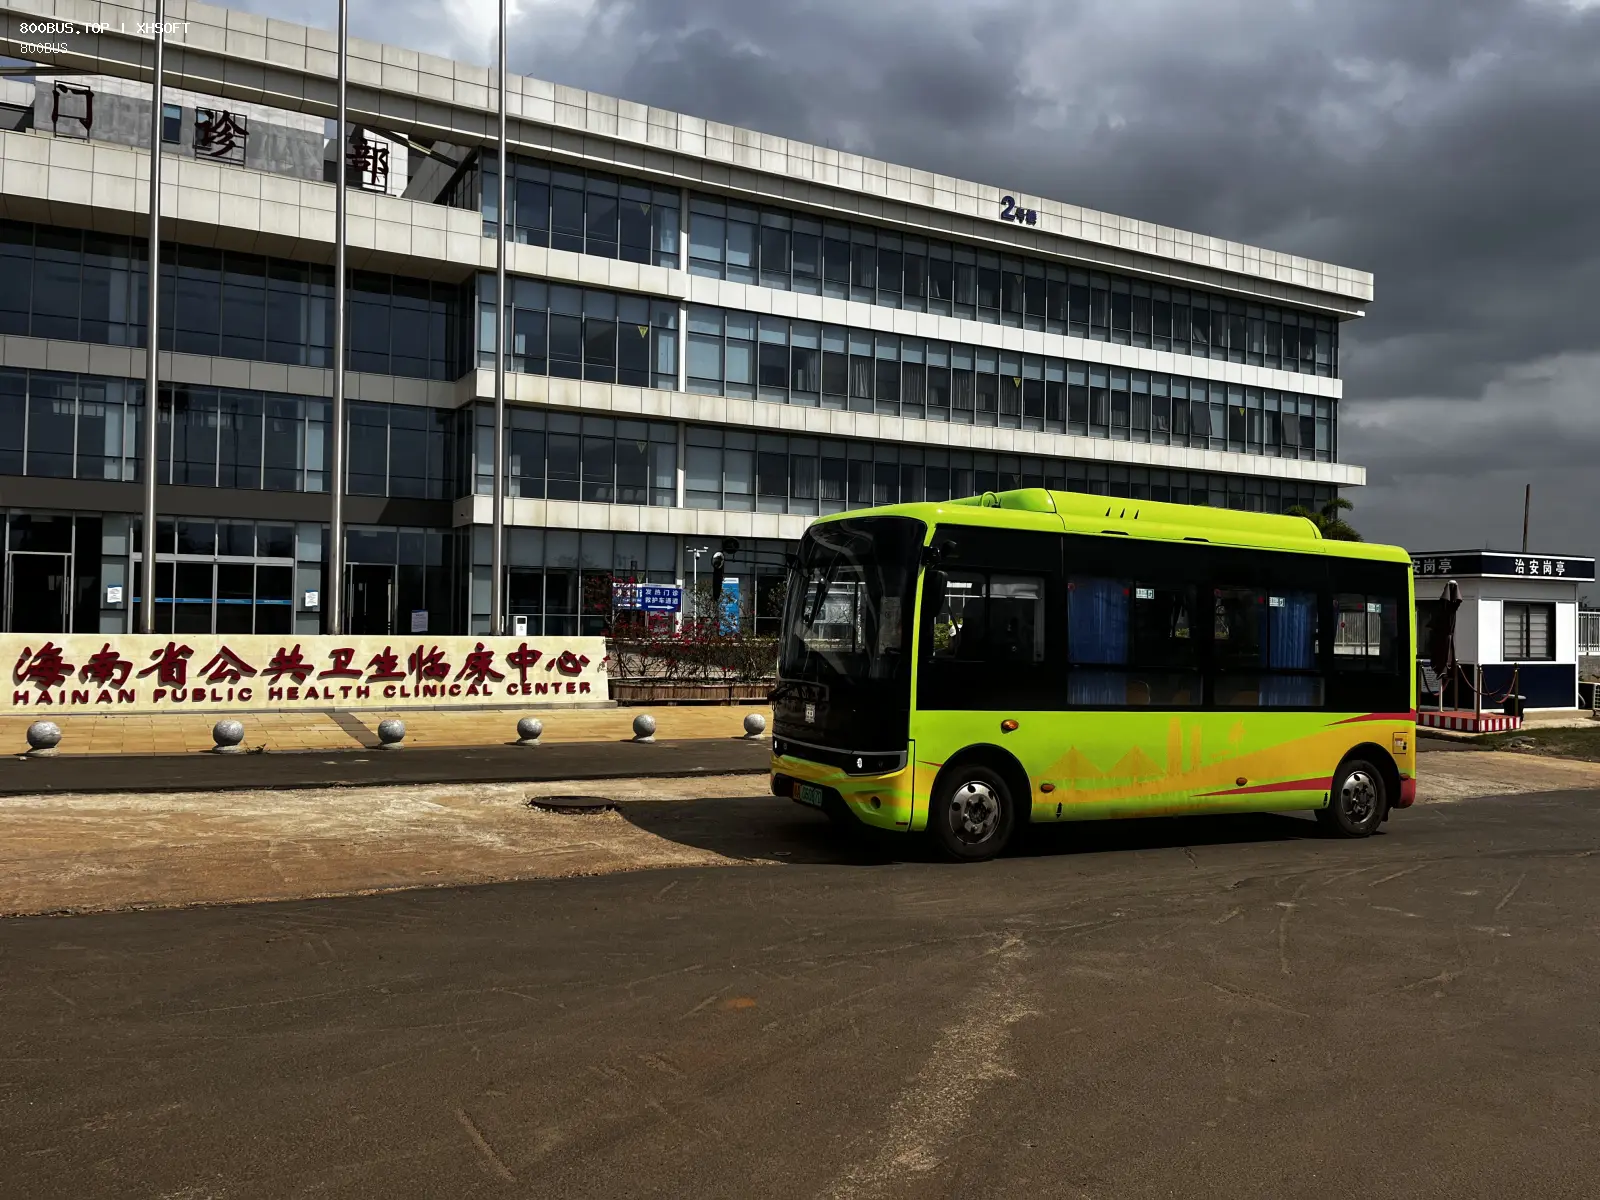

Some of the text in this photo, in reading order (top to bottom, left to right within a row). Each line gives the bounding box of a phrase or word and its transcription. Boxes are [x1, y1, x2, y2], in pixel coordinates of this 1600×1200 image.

[52, 82, 390, 187] 门诊部
[1514, 558, 1566, 576] 治安岗亭
[644, 588, 679, 596] 发热门诊
[644, 597, 679, 605] 救护车通道
[14, 641, 590, 688] 海南省公共卫生临床中心
[13, 681, 593, 706] HAINAN PUBLIC HEALTH CLINICAL CENTER
